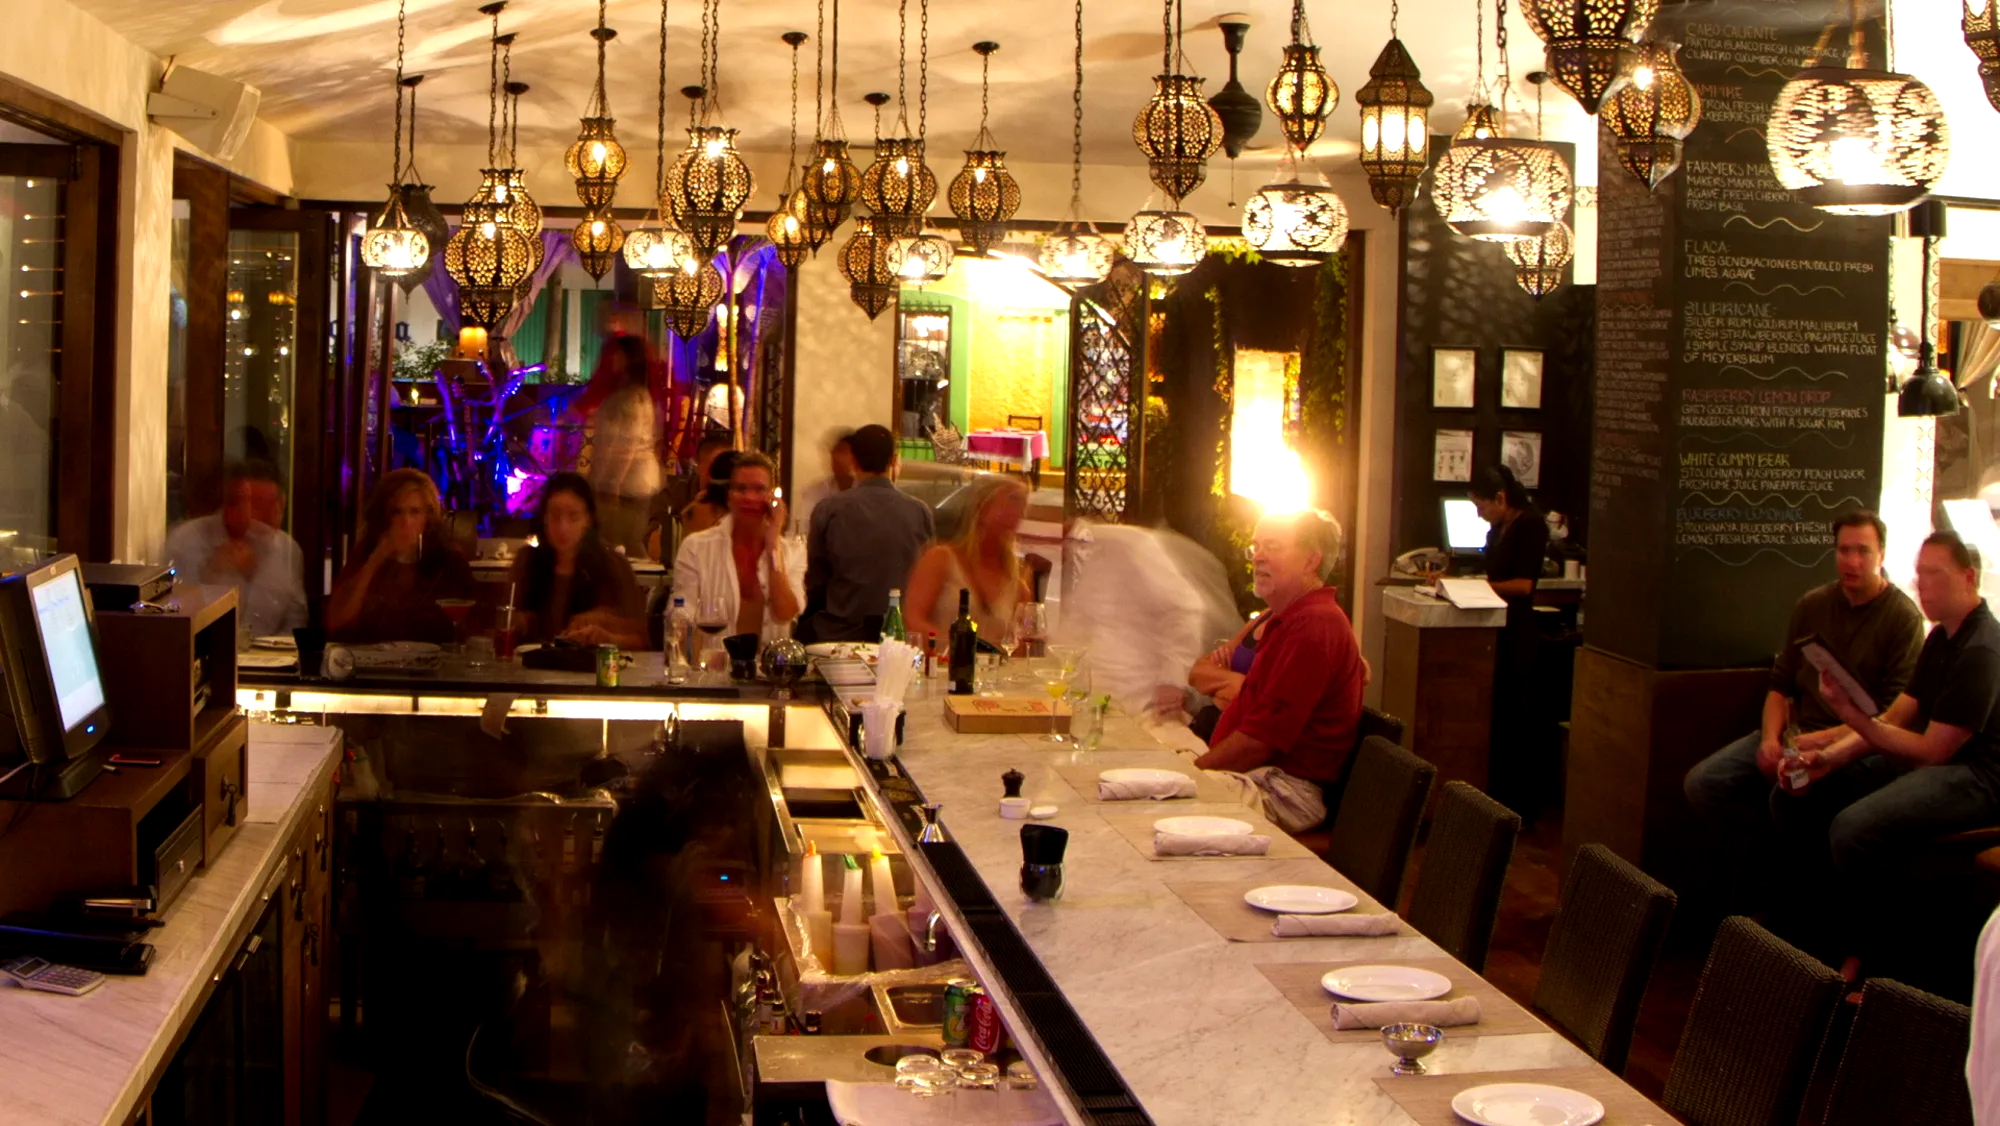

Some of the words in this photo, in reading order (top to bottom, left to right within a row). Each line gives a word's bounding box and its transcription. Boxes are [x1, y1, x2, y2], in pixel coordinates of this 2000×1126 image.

[1723, 24, 1779, 40] CALIENTE
[1686, 160, 1744, 177] FARMERS
[1686, 200, 1716, 212] FRESH
[1719, 202, 1746, 213] BASIL
[1686, 254, 1716, 267] TRES
[1844, 261, 1873, 273] FRESH
[1685, 316, 1725, 329] SILVER
[1684, 327, 1719, 340] FRESH
[1767, 342, 1810, 355] BLENDED
[1814, 344, 1839, 355] WITH
[1850, 345, 1878, 356] FLOAT
[1683, 352, 1699, 363] OF
[1772, 406, 1801, 417] FRESH
[1761, 417, 1786, 429] WITH
[1788, 418, 1796, 429] A
[1827, 419, 1846, 432] RIM
[1679, 452, 1715, 467] WHITE
[1717, 452, 1756, 468] GUMMY
[1757, 453, 1790, 468] BEAR
[1732, 480, 1758, 492] JUICE
[1760, 480, 1806, 492] PINEAPPLE
[1807, 481, 1834, 493] JUICE
[1795, 521, 1828, 534] FRESH
